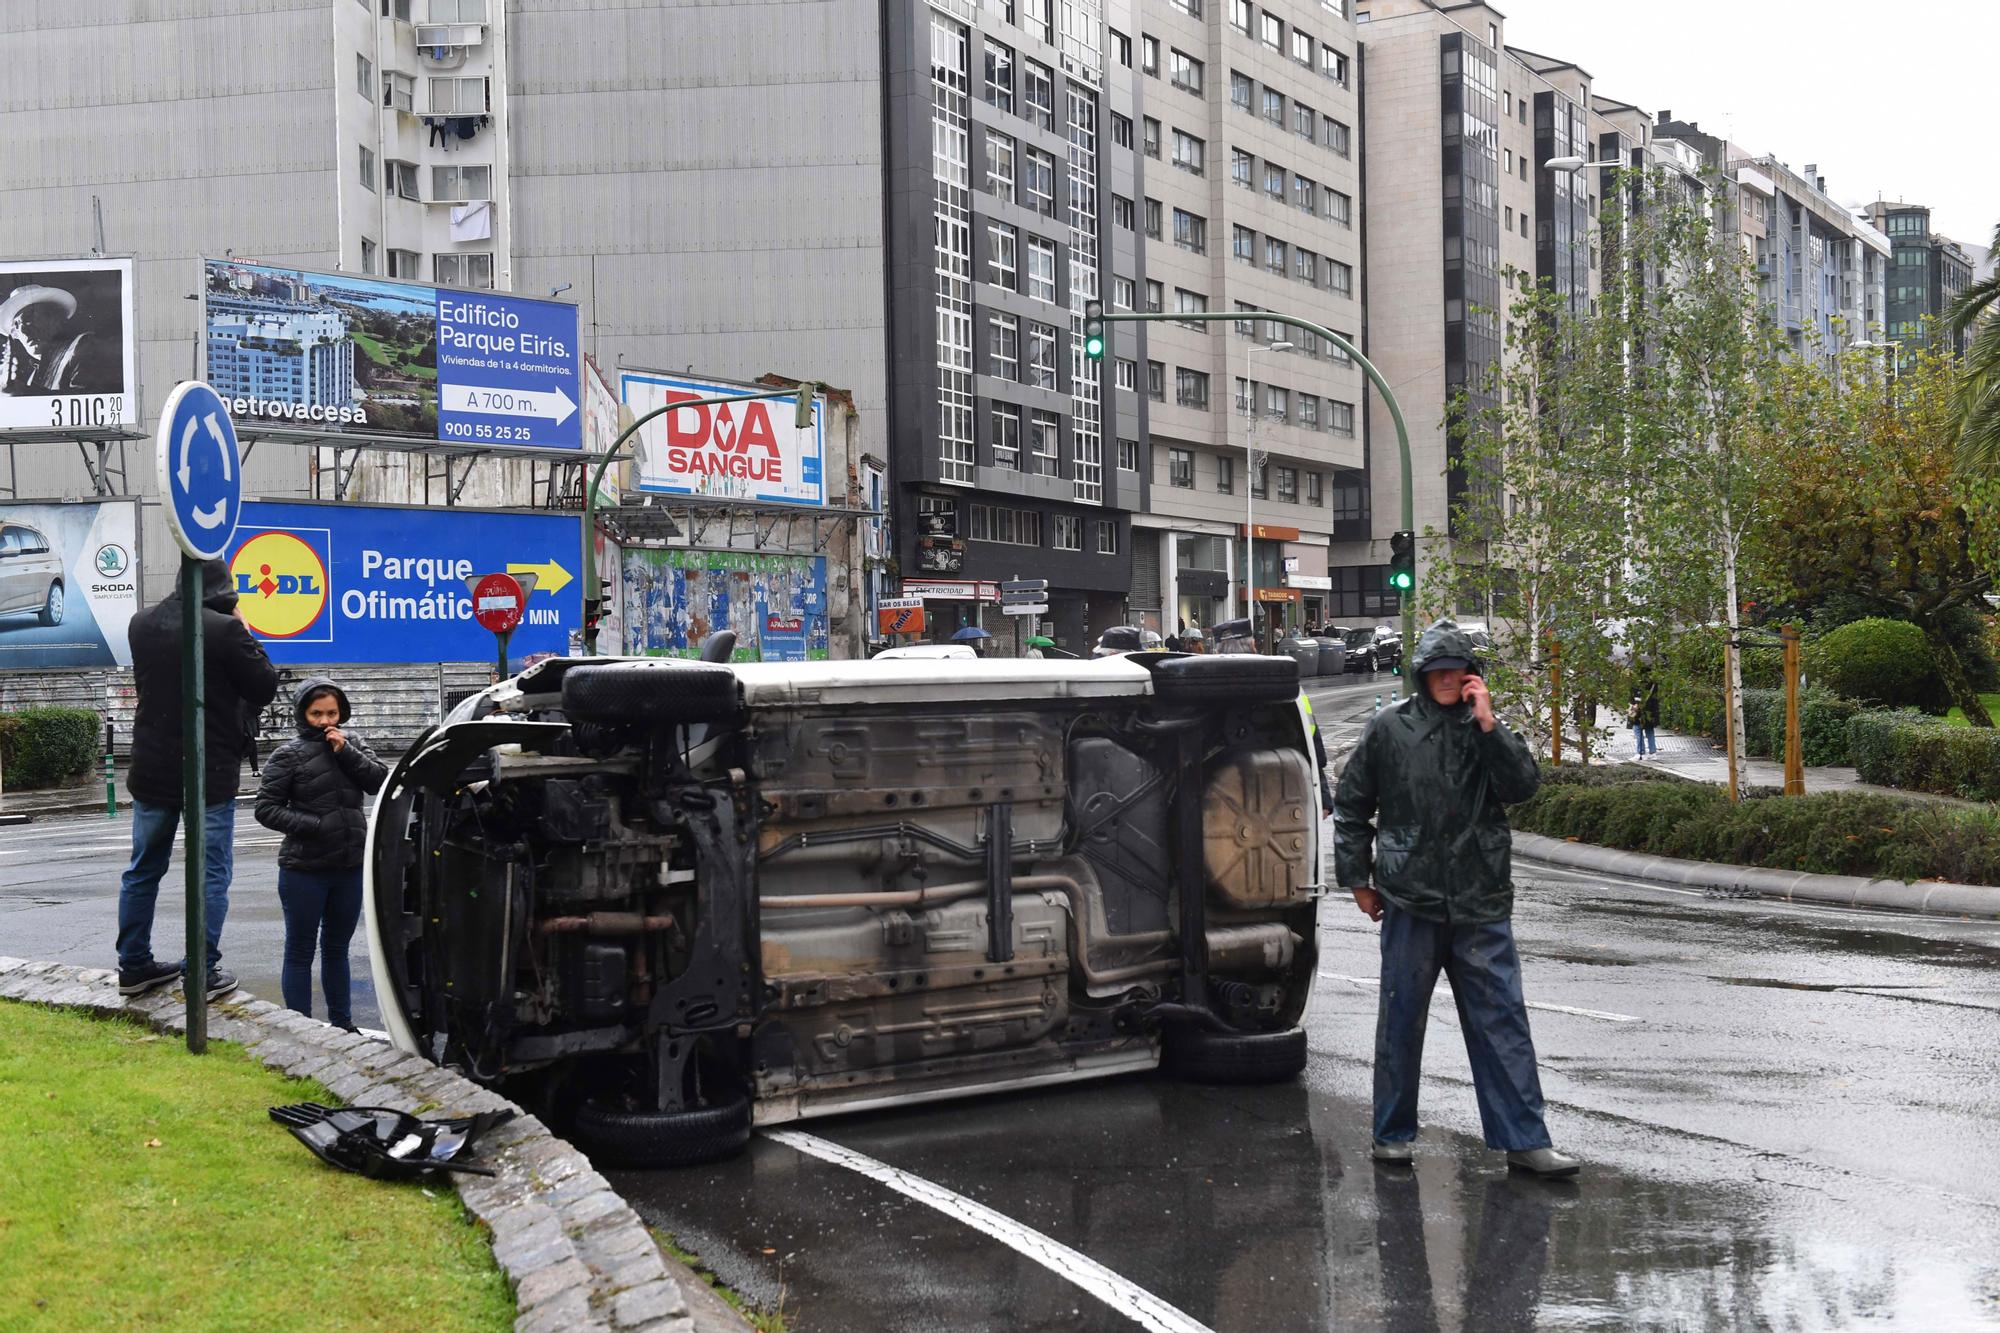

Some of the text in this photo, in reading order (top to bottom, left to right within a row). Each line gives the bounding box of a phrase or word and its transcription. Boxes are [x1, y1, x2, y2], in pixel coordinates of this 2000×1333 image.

[440, 300, 519, 329] Edificio
[440, 325, 570, 358] Parque Eirís.
[441, 354, 485, 367] Viviendas
[487, 359, 498, 368] de
[500, 361, 504, 369] 1
[512, 361, 519, 370] 4
[520, 362, 572, 375] dormitorios.
[51, 396, 122, 426] 3 DIC 20
[467, 391, 537, 412] A 700 m.
[110, 412, 121, 425] 21
[445, 422, 531, 440] 900 55 25 25
[668, 449, 782, 483] SANGUE
[362, 550, 473, 587] Parque
[91, 584, 135, 592] SKODA
[341, 589, 473, 619] Ofimátic
[529, 610, 560, 625] MIN
[889, 609, 913, 631] Fanta
